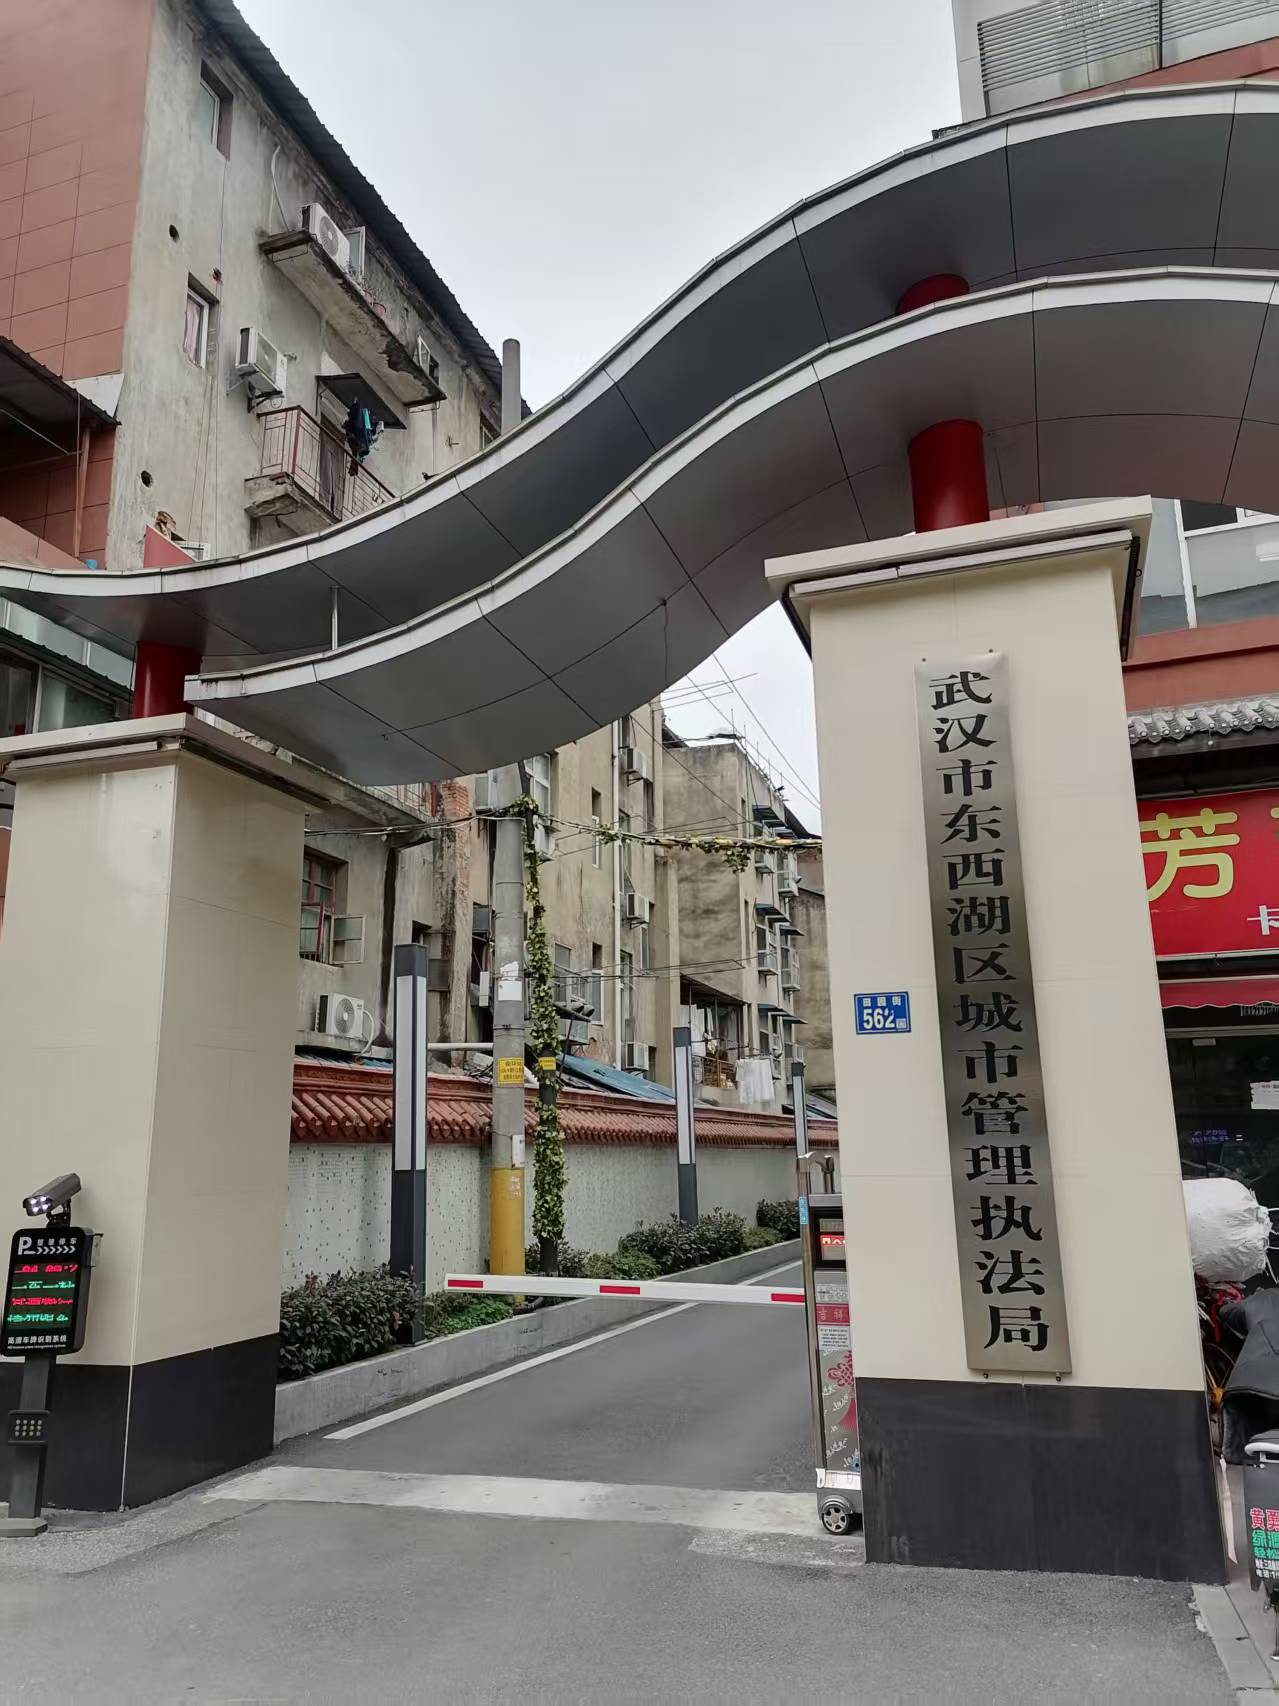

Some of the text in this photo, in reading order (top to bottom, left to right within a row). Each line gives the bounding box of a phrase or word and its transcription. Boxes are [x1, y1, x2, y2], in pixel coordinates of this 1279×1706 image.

[928, 670, 1049, 1352] 武汉市东西湖区城市管理执法局
[17, 1236, 33, 1255] P
